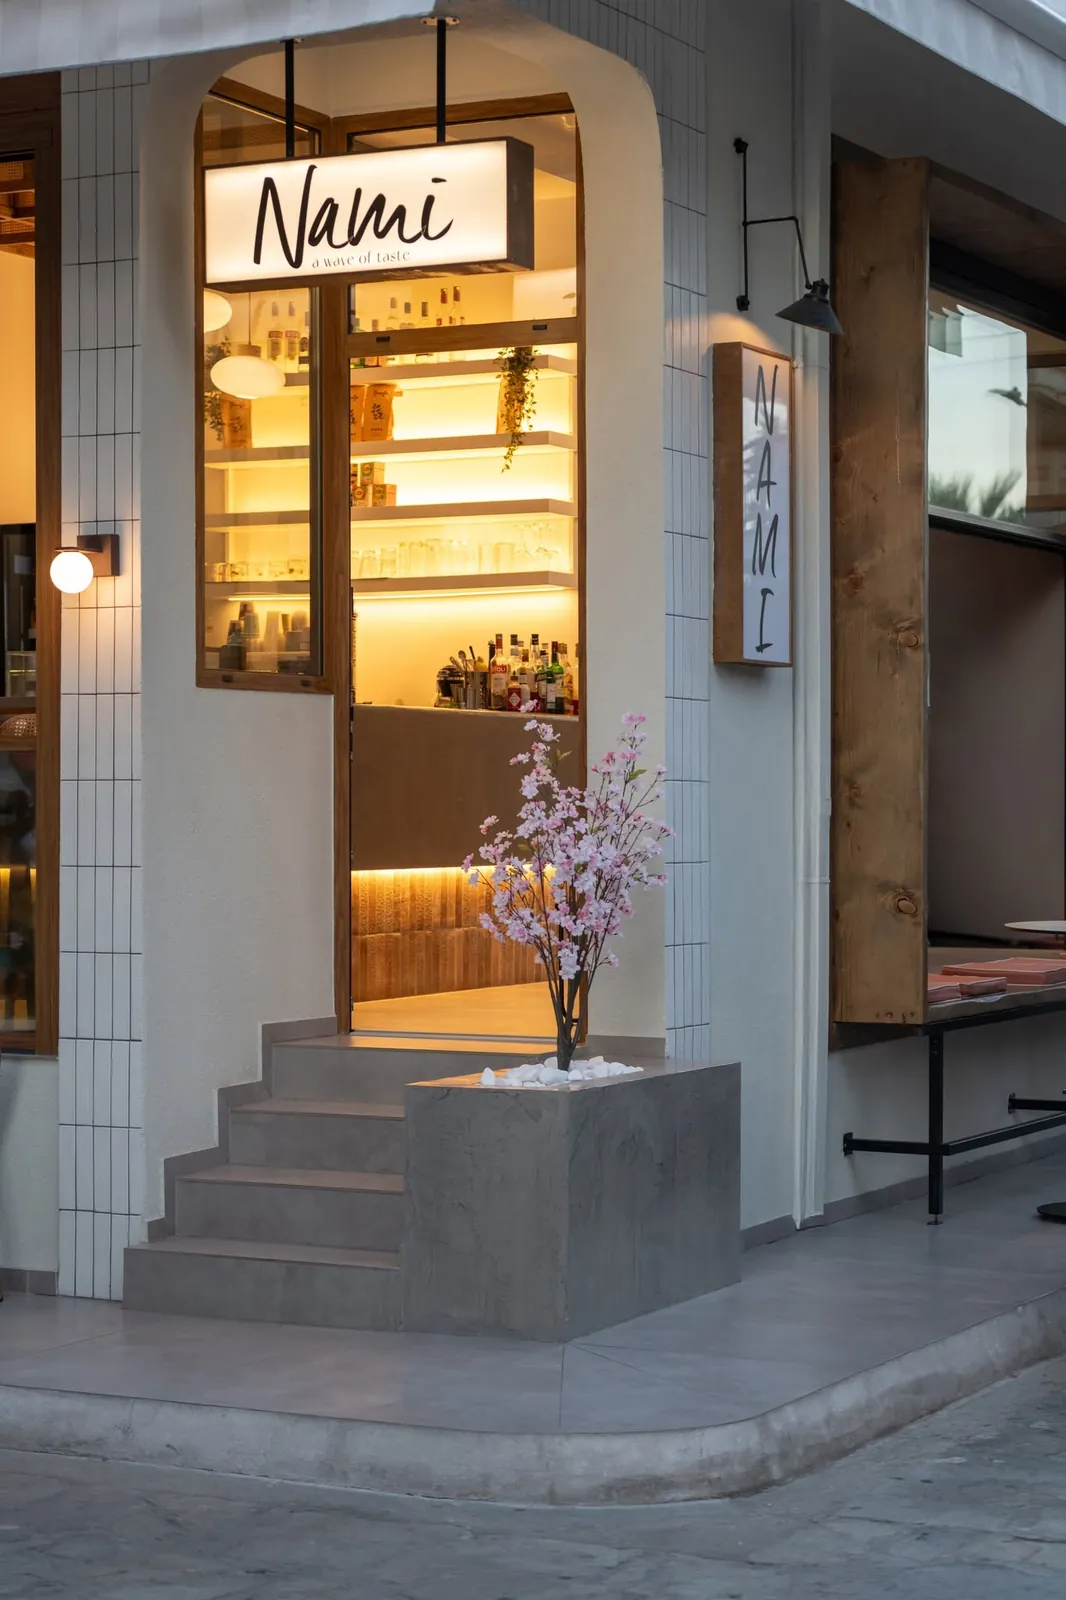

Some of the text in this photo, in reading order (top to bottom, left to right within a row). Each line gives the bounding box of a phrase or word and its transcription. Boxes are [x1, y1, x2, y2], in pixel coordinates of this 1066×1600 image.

[253, 164, 454, 269] Nami
[312, 250, 410, 269] a wave of taste
[752, 364, 779, 653] NAMI
